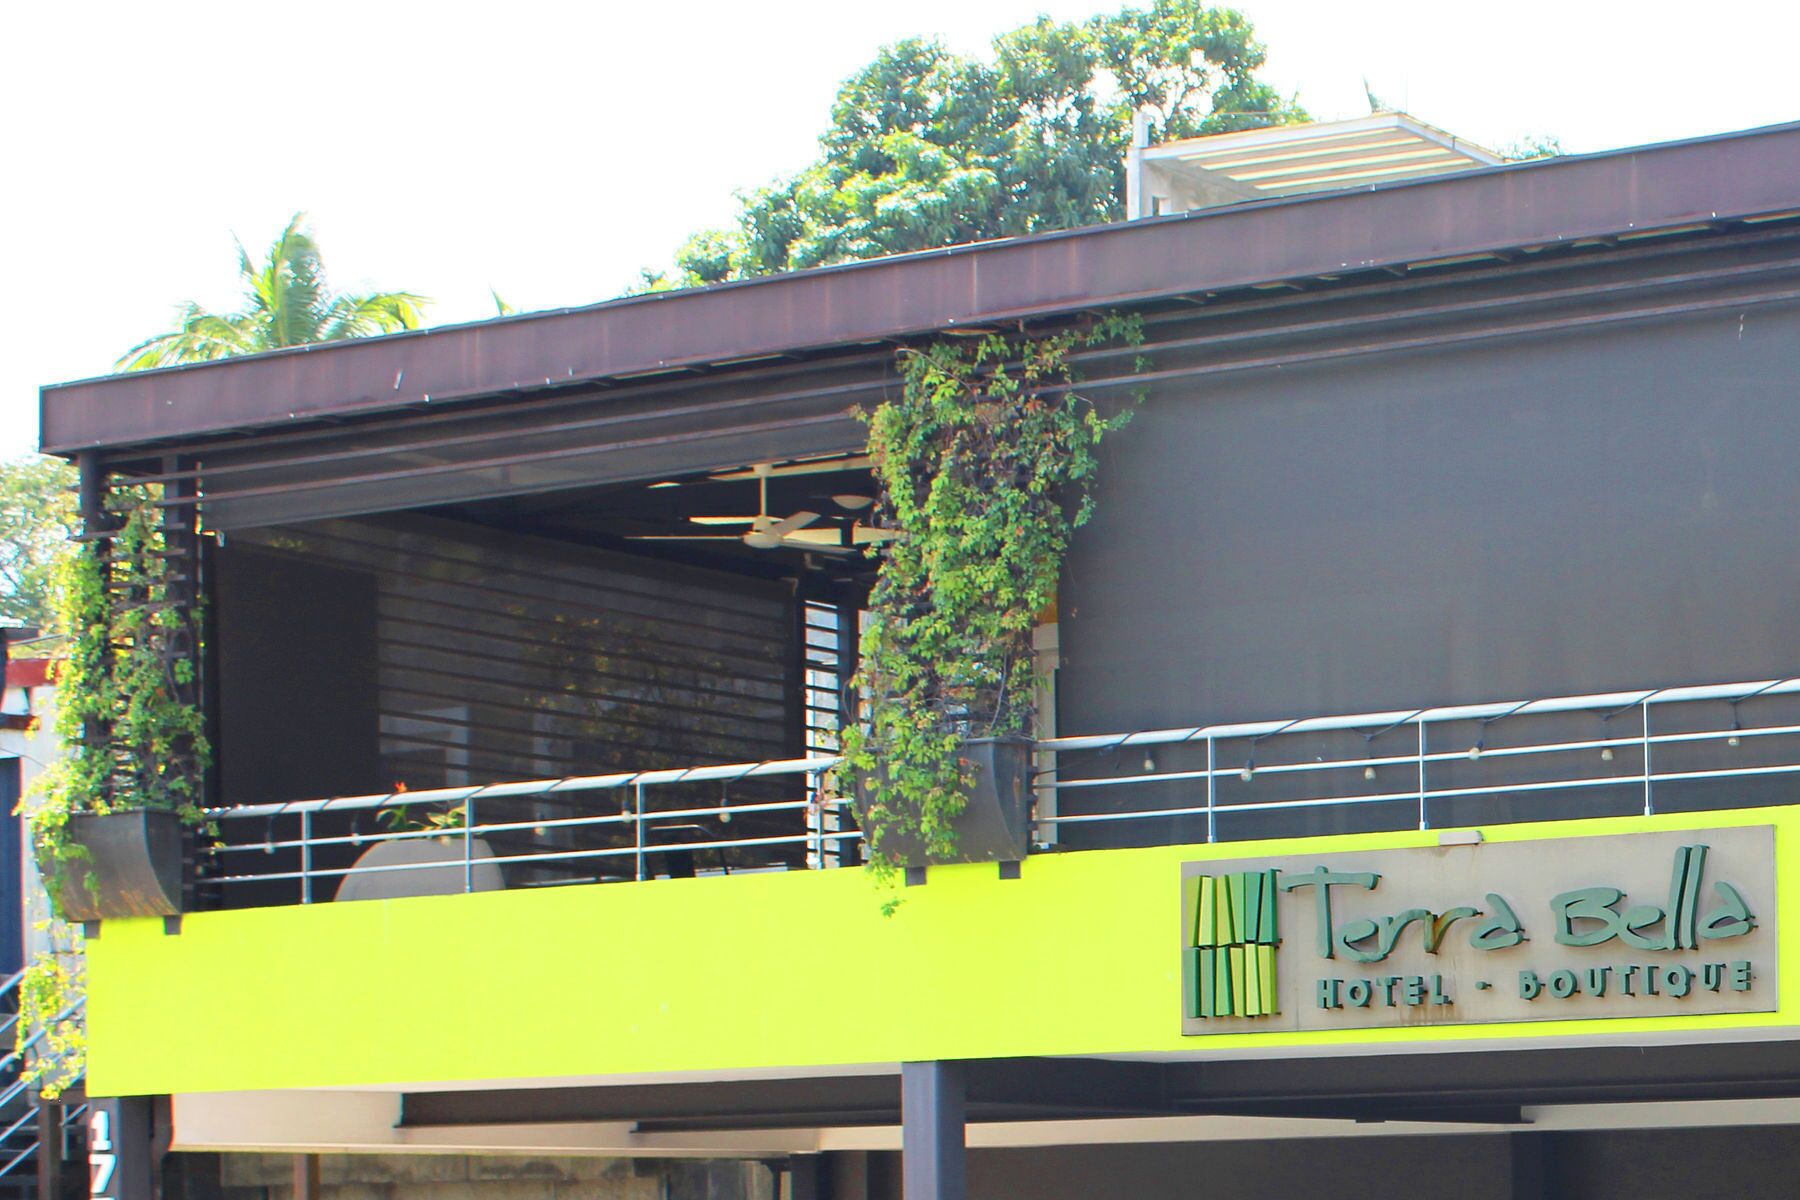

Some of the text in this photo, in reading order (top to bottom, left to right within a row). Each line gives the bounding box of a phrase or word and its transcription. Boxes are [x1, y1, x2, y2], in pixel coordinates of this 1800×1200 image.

[1280, 844, 1758, 964] Terra Bella
[1316, 960, 1755, 1010] HOTEL BOUTIQUE
